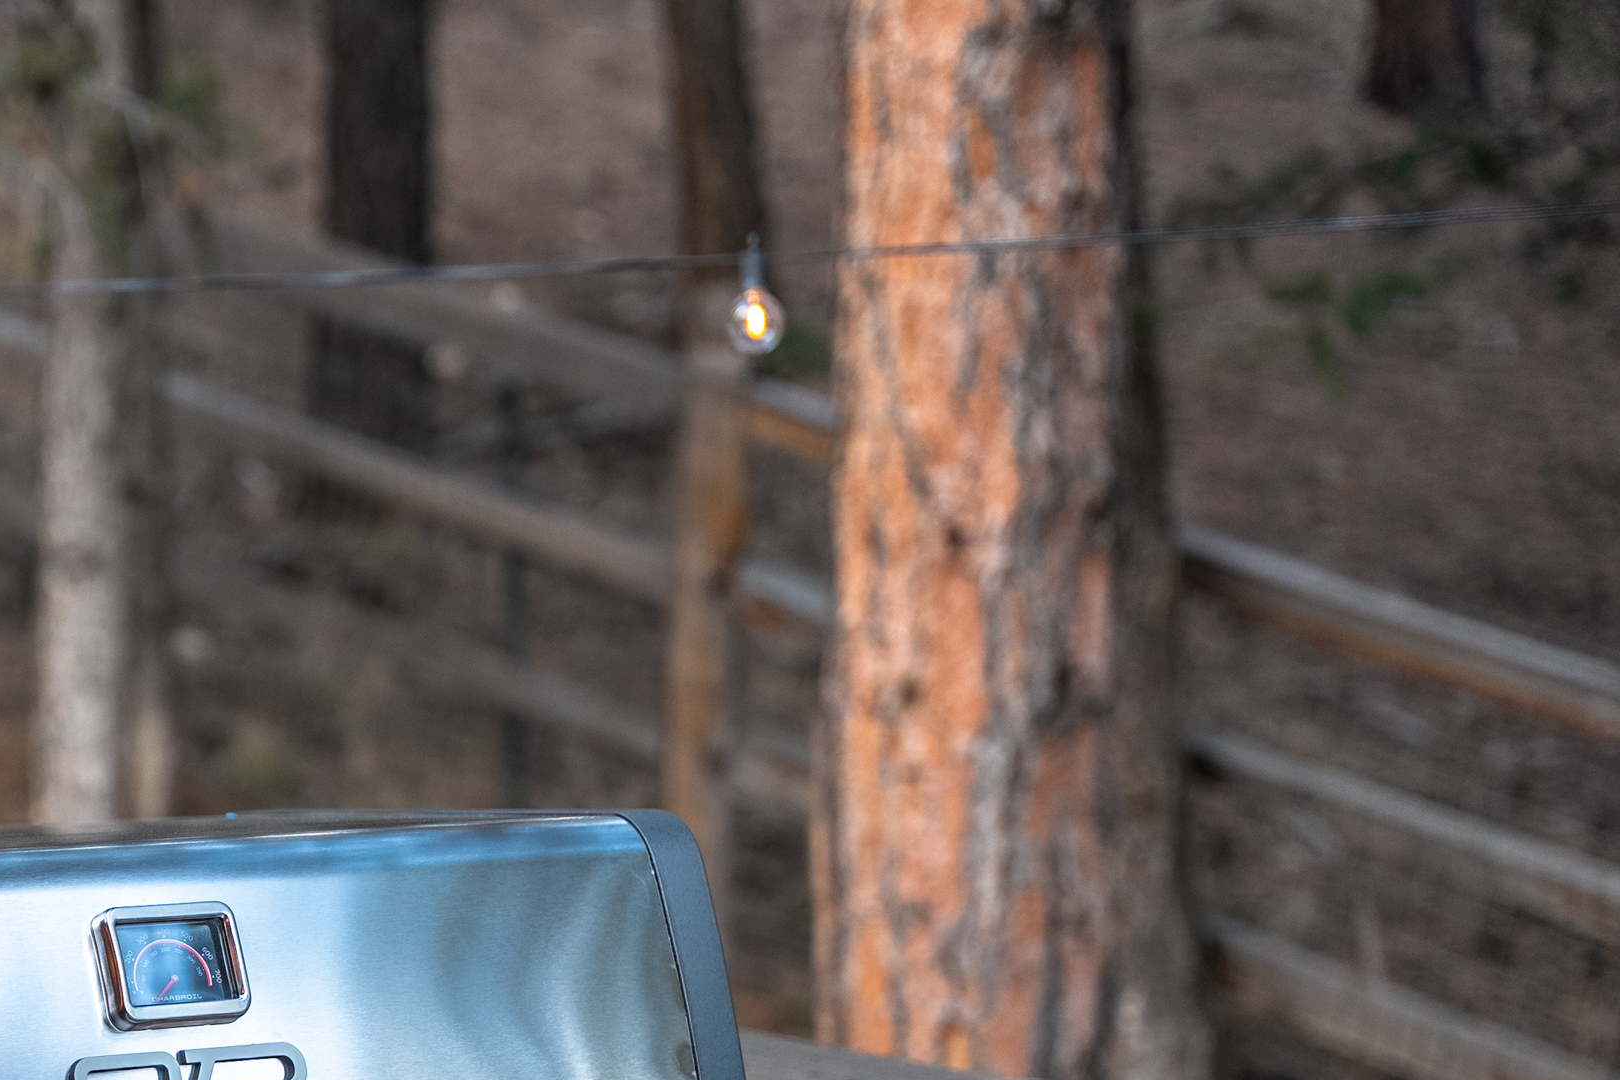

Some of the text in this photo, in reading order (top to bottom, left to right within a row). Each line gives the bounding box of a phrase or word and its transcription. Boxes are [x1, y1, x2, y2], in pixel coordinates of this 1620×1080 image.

[201, 946, 214, 960] 600
[214, 968, 222, 984] 700
[151, 993, 202, 1002] CHARBROIL
